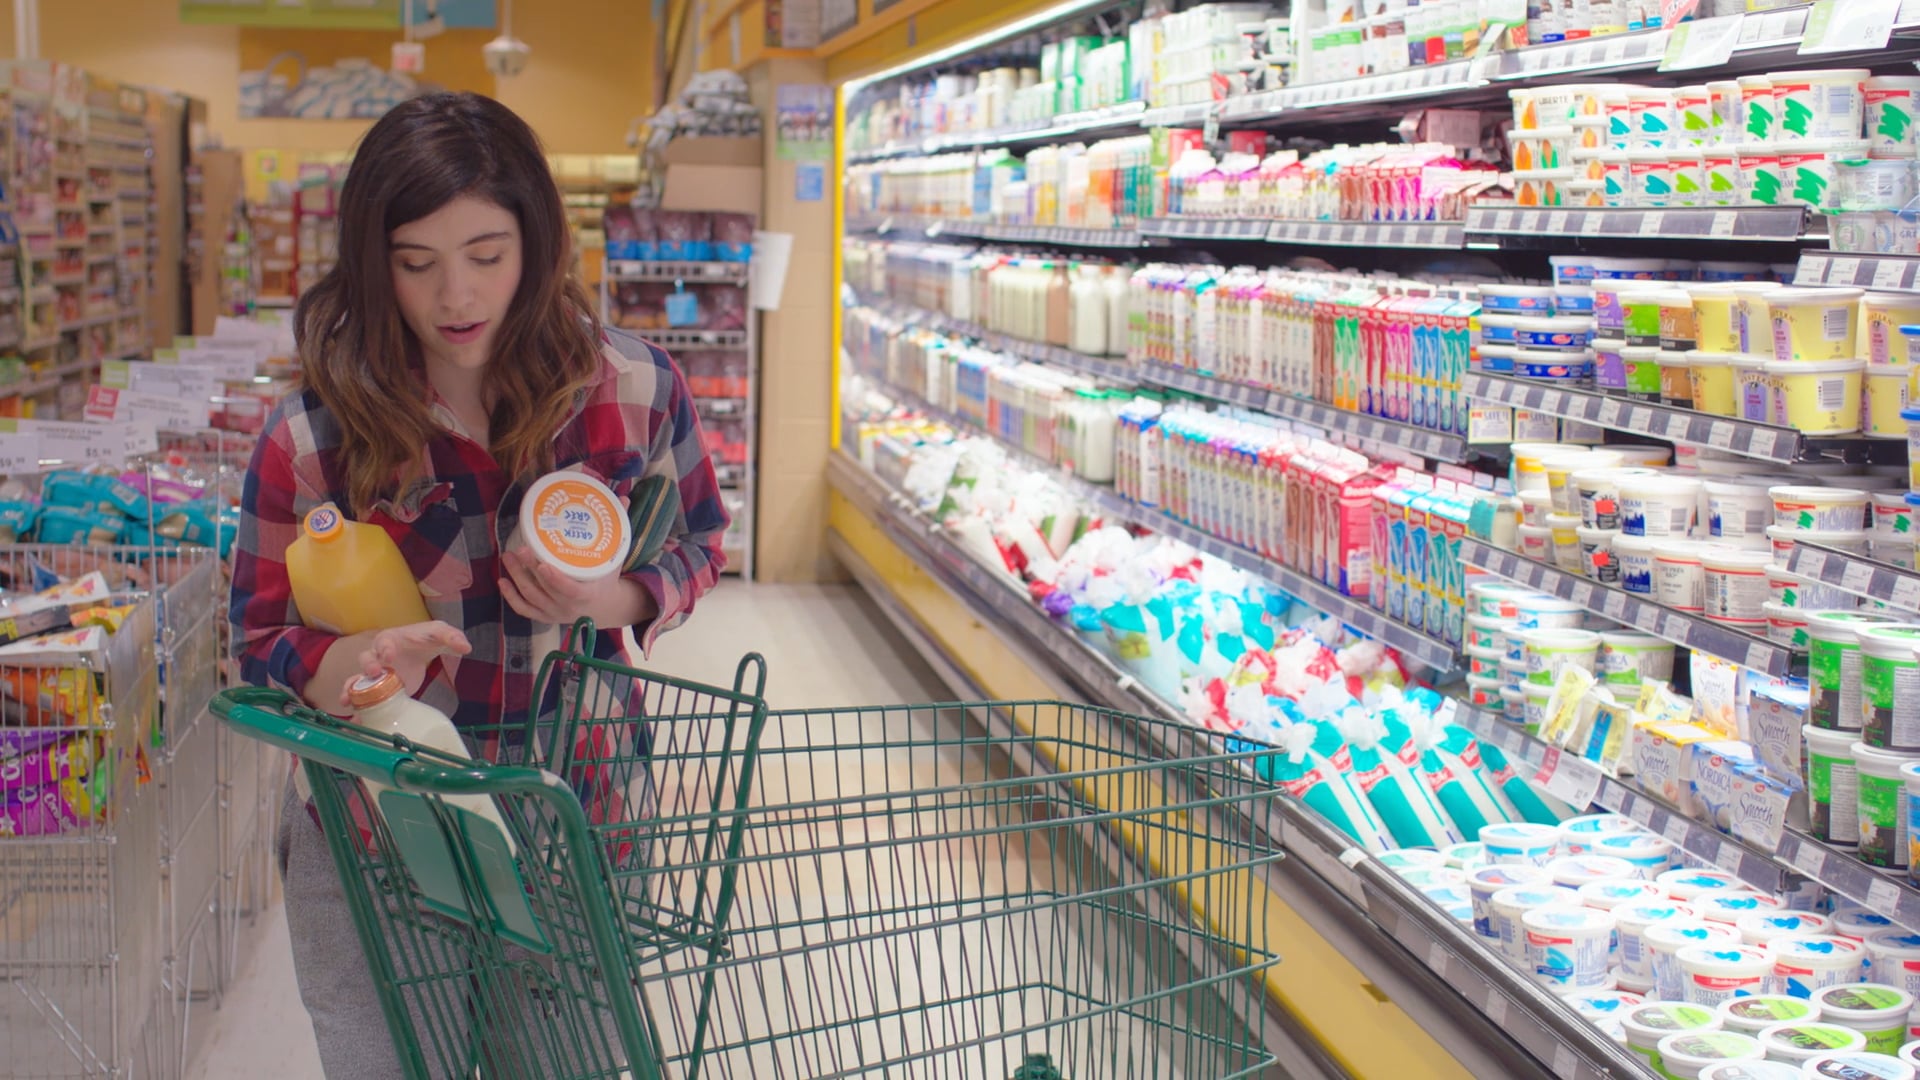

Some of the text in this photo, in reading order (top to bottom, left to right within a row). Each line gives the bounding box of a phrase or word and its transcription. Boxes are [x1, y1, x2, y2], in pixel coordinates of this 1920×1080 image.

[564, 510, 592, 521] GREC
[563, 528, 593, 541] GREEK
[1754, 713, 1791, 745] Smooth
[1636, 745, 1671, 778] Smooth
[1697, 760, 1731, 791] NORDICA
[1735, 791, 1774, 826] Smooth
